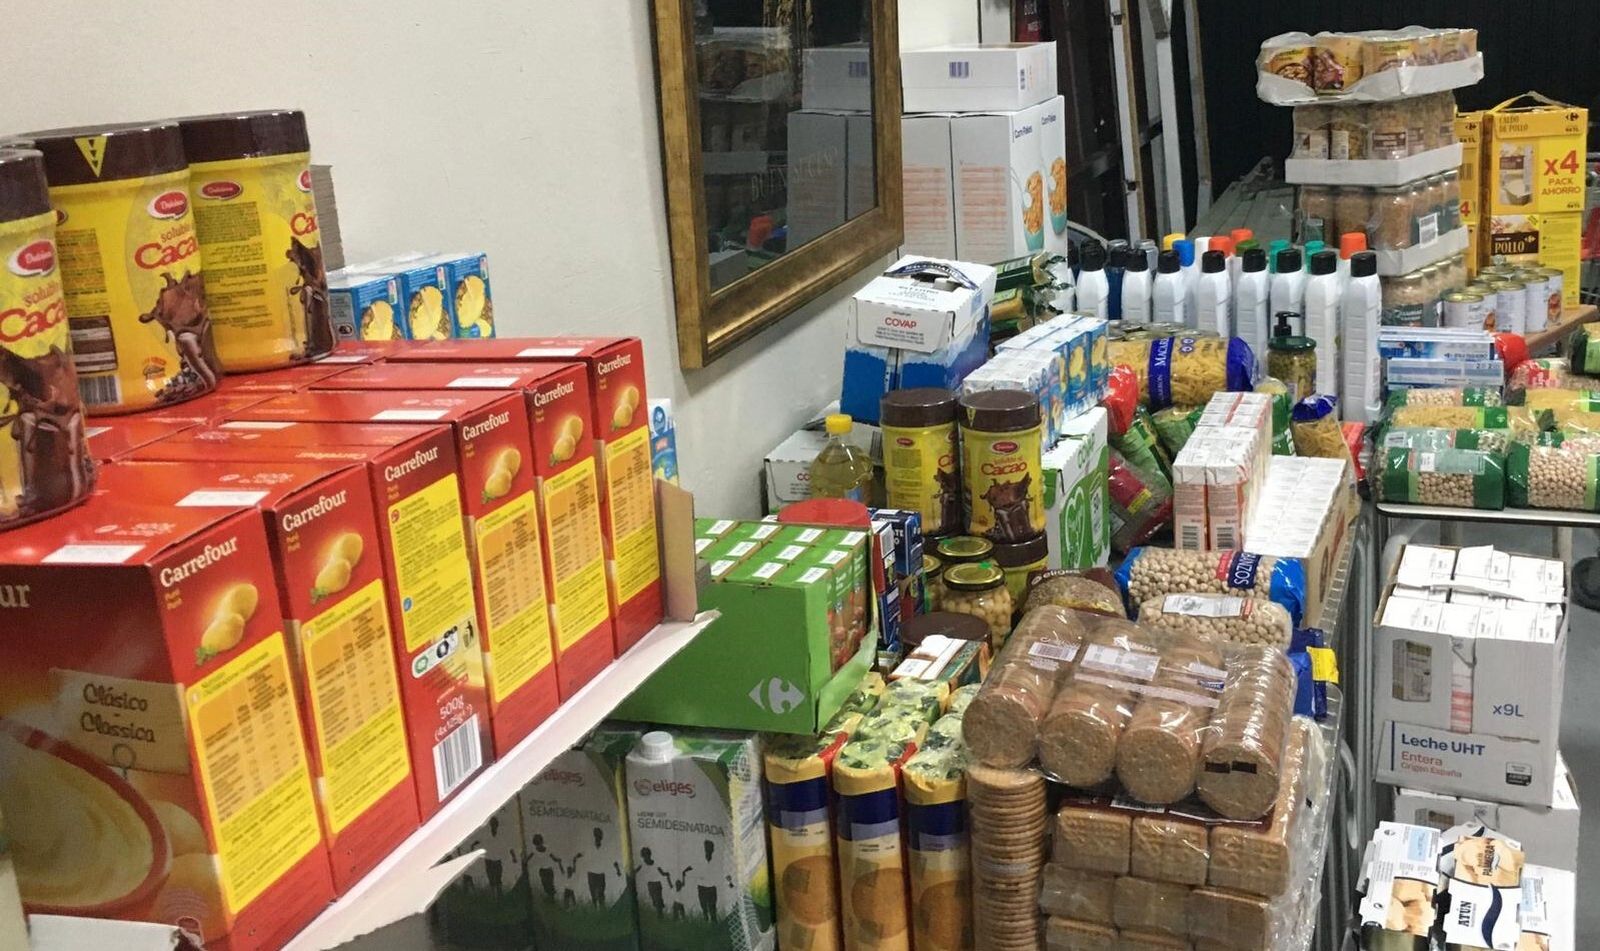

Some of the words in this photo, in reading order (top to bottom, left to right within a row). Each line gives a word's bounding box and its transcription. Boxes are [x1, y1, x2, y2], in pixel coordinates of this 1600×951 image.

[1541, 185, 1581, 196] AHORRO
[1548, 177, 1574, 186] PACK
[1494, 239, 1526, 254] POLLO
[884, 316, 917, 329] COVAP
[597, 352, 632, 376] Carrefour
[533, 380, 575, 408] Carrefour
[462, 409, 510, 441] Carrefour
[384, 444, 439, 482] Carrefour
[980, 462, 1028, 476] Cacao
[282, 489, 347, 533] Carrefour
[159, 536, 238, 588] Carrefour
[83, 682, 148, 712] Clásico
[1492, 702, 1525, 718] x9L
[1401, 732, 1449, 751] Leche
[1451, 740, 1486, 756] UHT
[1401, 750, 1443, 766] Entera
[1401, 761, 1430, 773] Origen
[653, 779, 697, 798] eliges
[636, 816, 725, 838] SEMIDESNATADA
